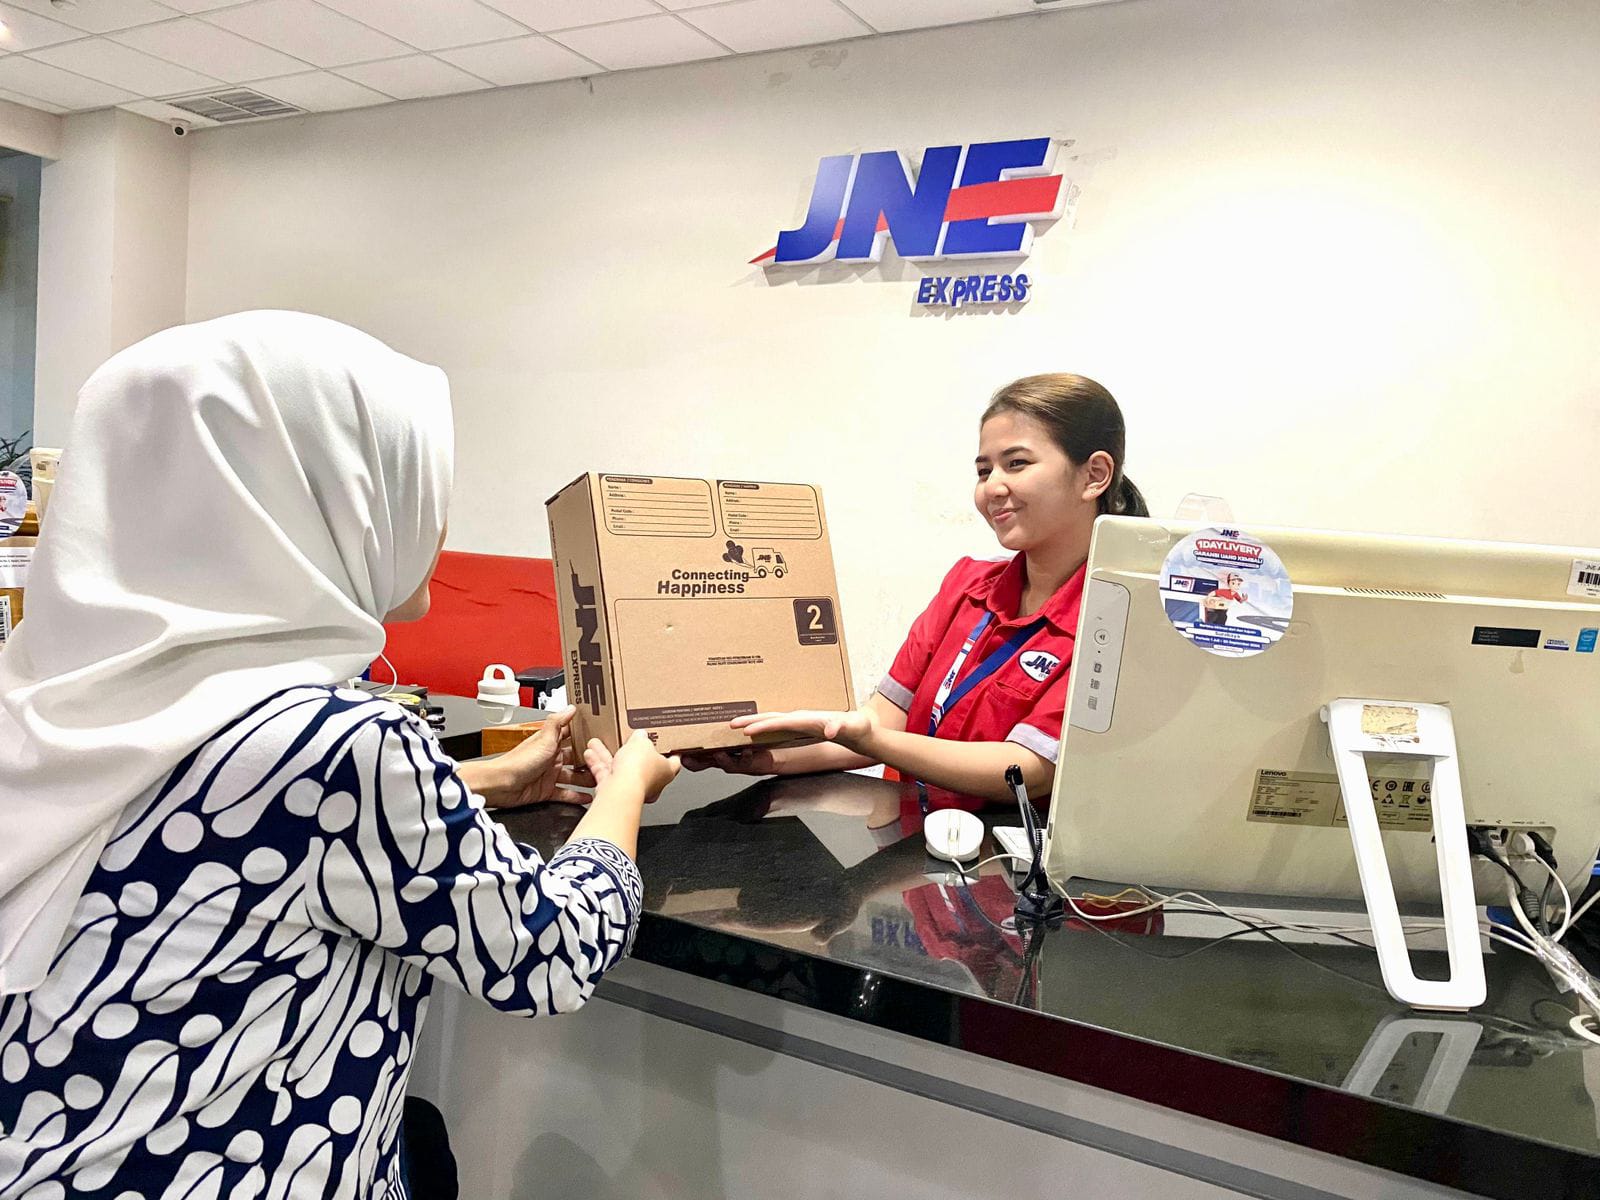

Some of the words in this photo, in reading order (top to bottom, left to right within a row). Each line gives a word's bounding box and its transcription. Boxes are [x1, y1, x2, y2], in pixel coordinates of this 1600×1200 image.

[749, 137, 1064, 263] JNE
[917, 274, 1030, 307] EXPRESS
[1220, 529, 1240, 537] JNE
[1197, 541, 1260, 556] 1DAYLIVERY
[672, 569, 749, 583] Connecting
[657, 581, 745, 597] Happiness
[807, 604, 824, 630] 2
[569, 559, 607, 716] JNE
[571, 650, 582, 705] EXPRESS
[1261, 769, 1287, 777] Lenovo
